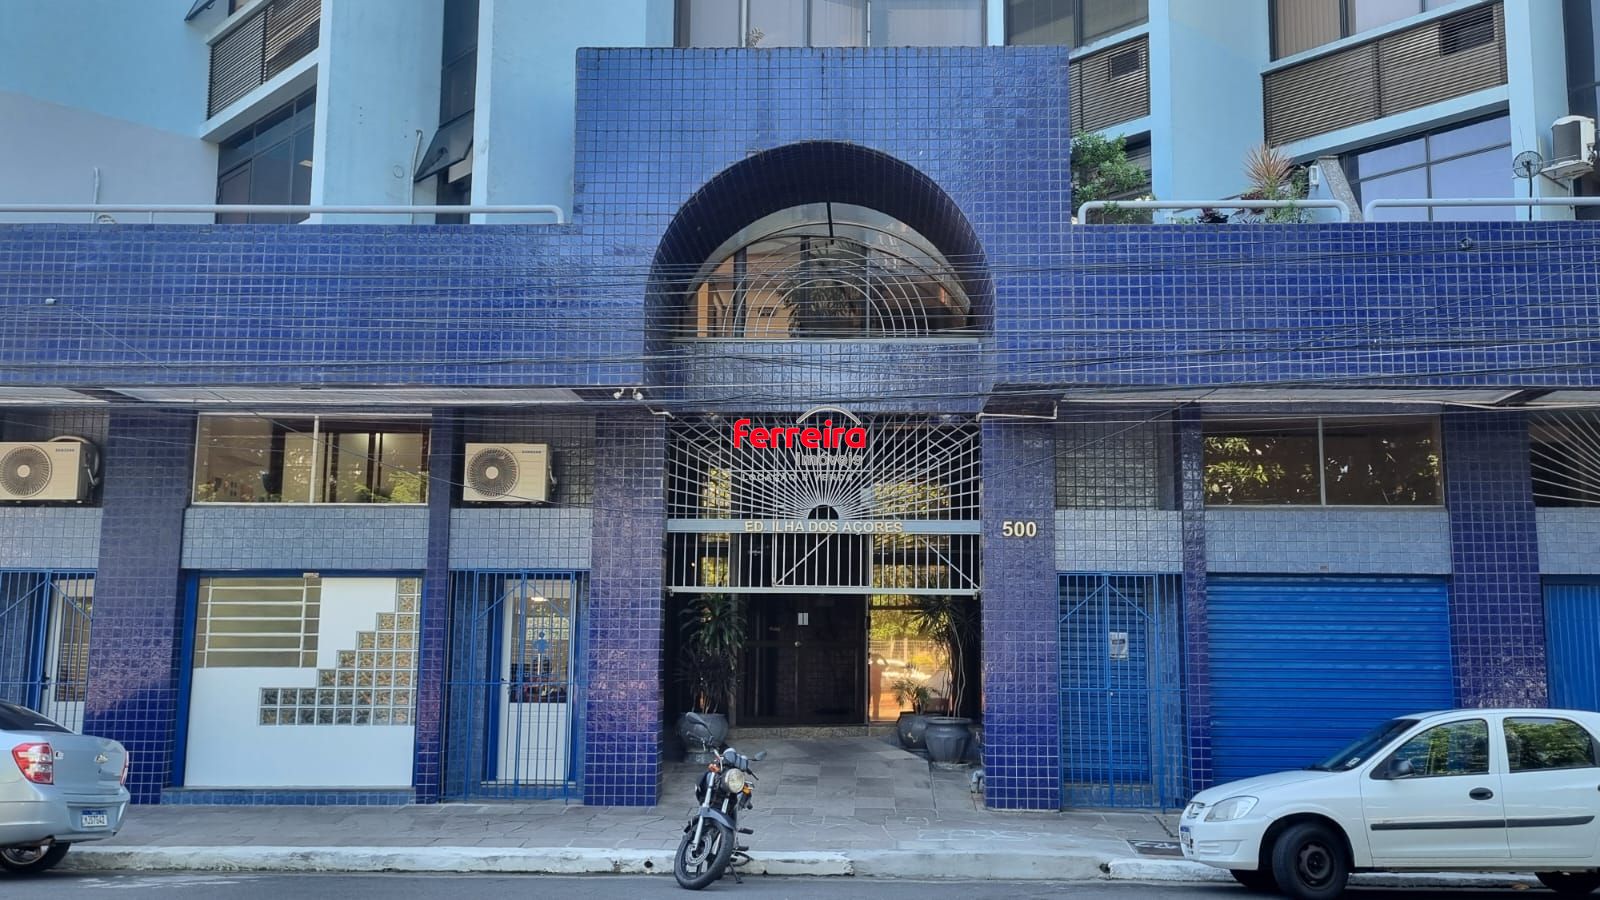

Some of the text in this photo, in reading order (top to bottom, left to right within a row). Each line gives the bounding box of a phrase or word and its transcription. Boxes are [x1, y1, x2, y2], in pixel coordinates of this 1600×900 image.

[744, 520, 903, 535] ED. ILHA DOS AÇORES
[1002, 520, 1037, 537] 500
